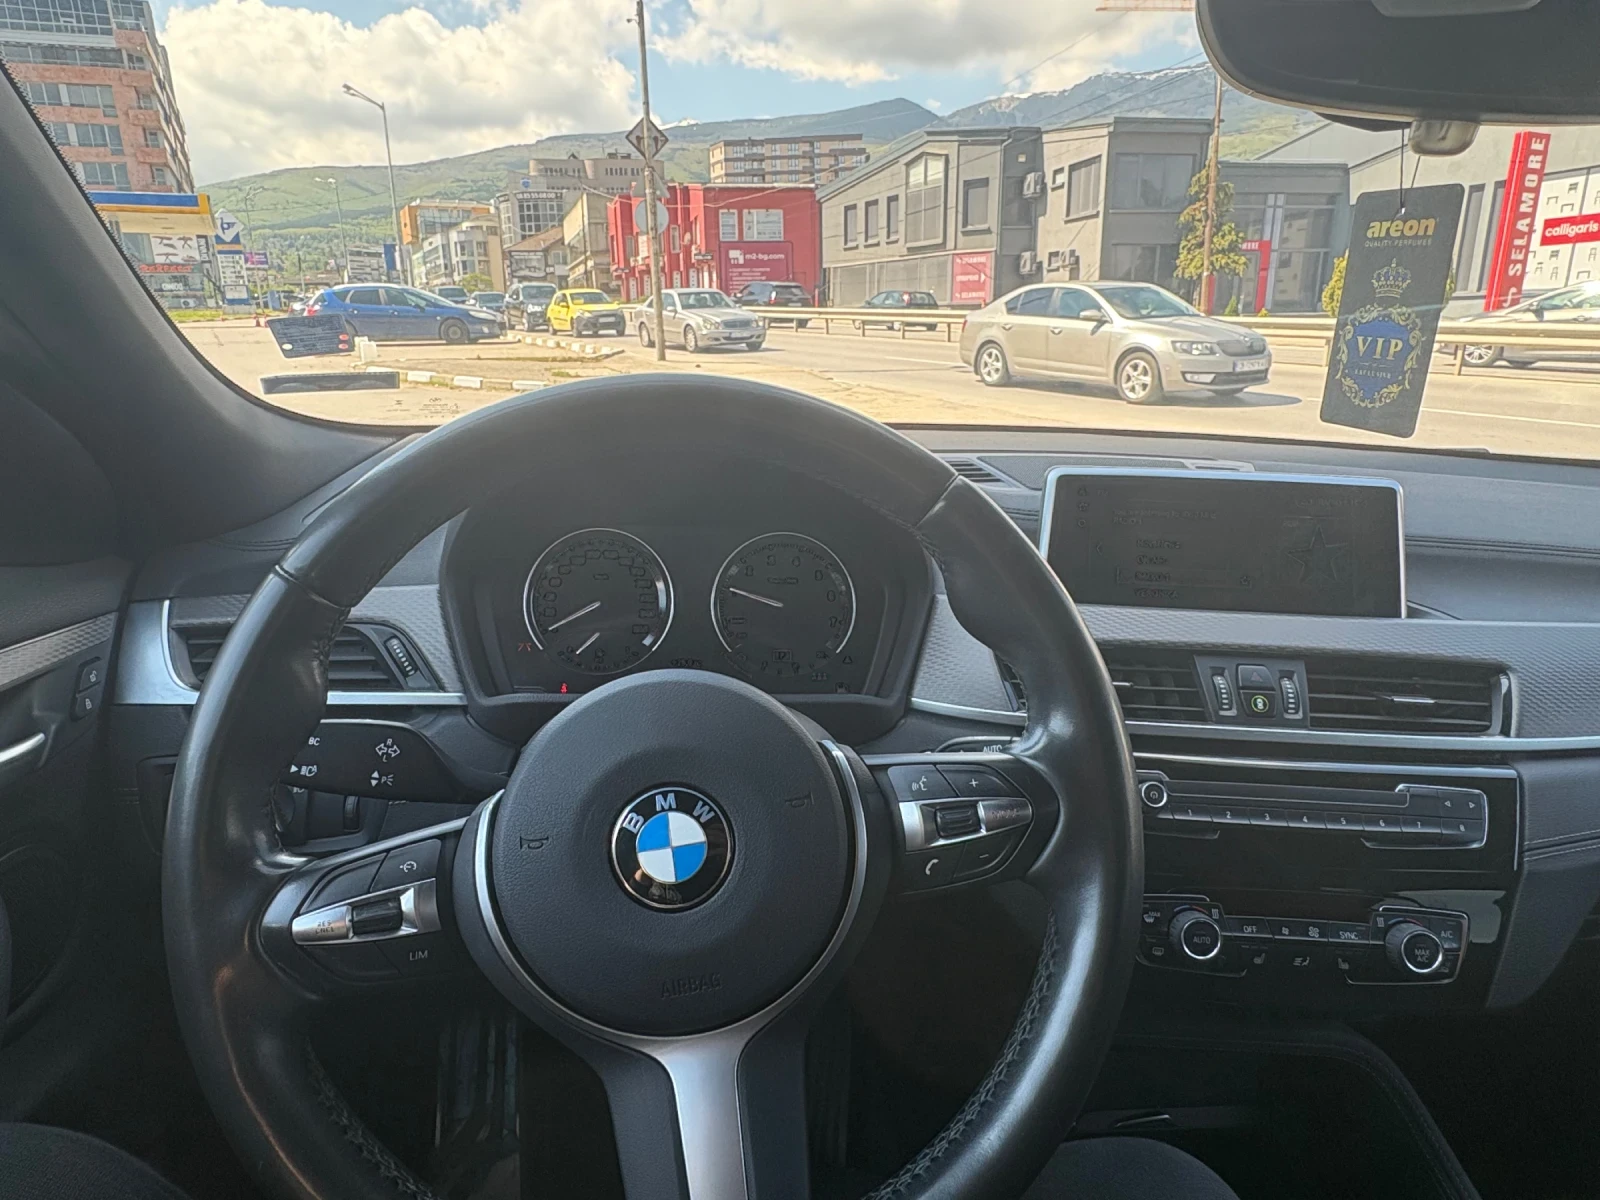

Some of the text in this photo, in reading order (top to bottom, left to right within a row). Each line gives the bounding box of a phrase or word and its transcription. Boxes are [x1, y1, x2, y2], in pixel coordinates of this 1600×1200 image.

[1508, 137, 1546, 277] SELAMORE
[1366, 218, 1436, 238] areon
[1544, 220, 1599, 237] calligaris
[1365, 238, 1432, 248] QUALITY PERFUMES
[1356, 336, 1403, 361] VIP
[308, 736, 320, 746] BC
[386, 738, 392, 746] R
[622, 793, 716, 834] BMW
[1243, 925, 1257, 934] OFF
[1440, 929, 1453, 938] A/C
[1193, 935, 1211, 945] AUTO
[1339, 930, 1359, 940] SYNC
[409, 951, 428, 961] LIM
[1417, 955, 1429, 963] A/C
[660, 973, 721, 998] AIRBAG
